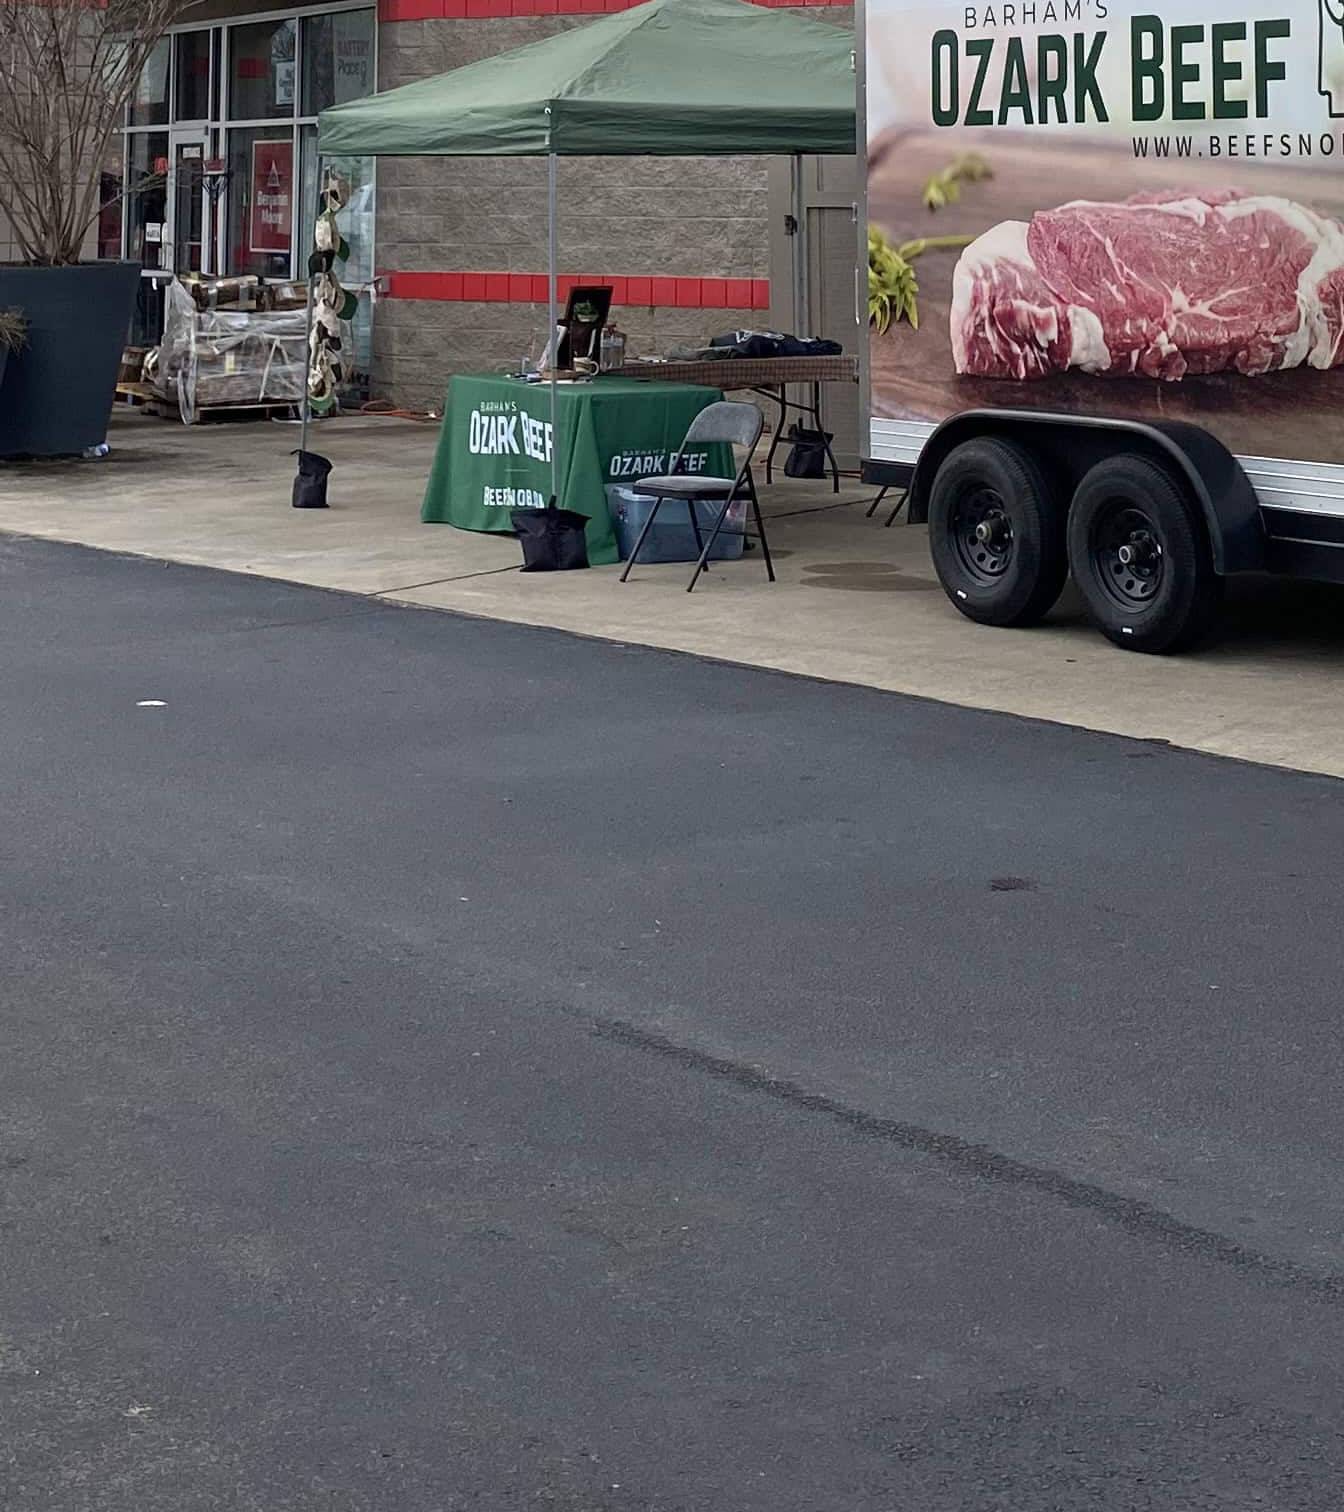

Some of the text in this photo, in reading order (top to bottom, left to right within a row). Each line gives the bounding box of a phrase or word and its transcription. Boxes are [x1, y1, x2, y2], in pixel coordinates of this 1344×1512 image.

[931, 14, 1291, 127] OZARK BEEF
[470, 409, 520, 455] OZARK
[609, 455, 664, 476] OZARK
